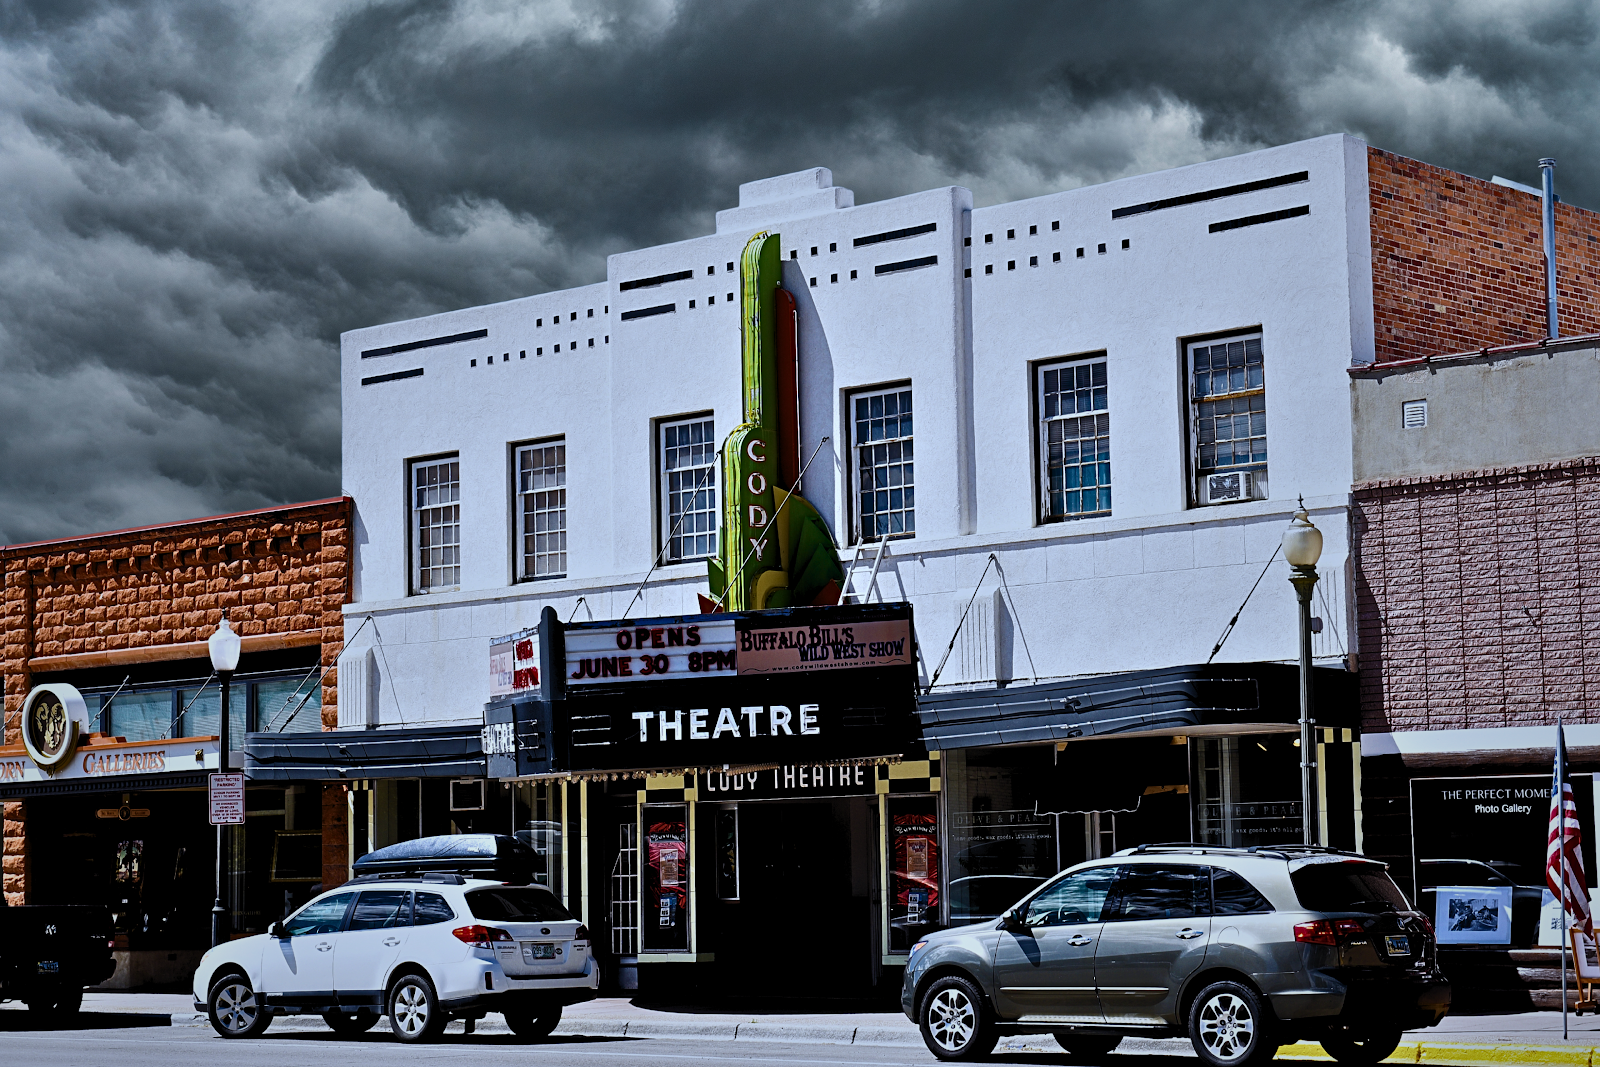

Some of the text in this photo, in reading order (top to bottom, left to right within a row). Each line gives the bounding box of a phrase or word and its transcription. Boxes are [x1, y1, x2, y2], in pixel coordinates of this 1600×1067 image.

[746, 439, 768, 562] CODY
[616, 625, 701, 650] OPENS
[798, 637, 905, 662] WILD WEST SHOW
[571, 649, 737, 679] JUNE 30 8PM
[631, 703, 821, 743] THEATRE
[82, 750, 166, 774] GALLERIES
[1441, 790, 1463, 800] THE
[1465, 788, 1512, 799] PERFECT
[957, 814, 991, 825] OLIVE
[1203, 806, 1242, 817] OLE
[1474, 804, 1532, 815] Photo Gallery
